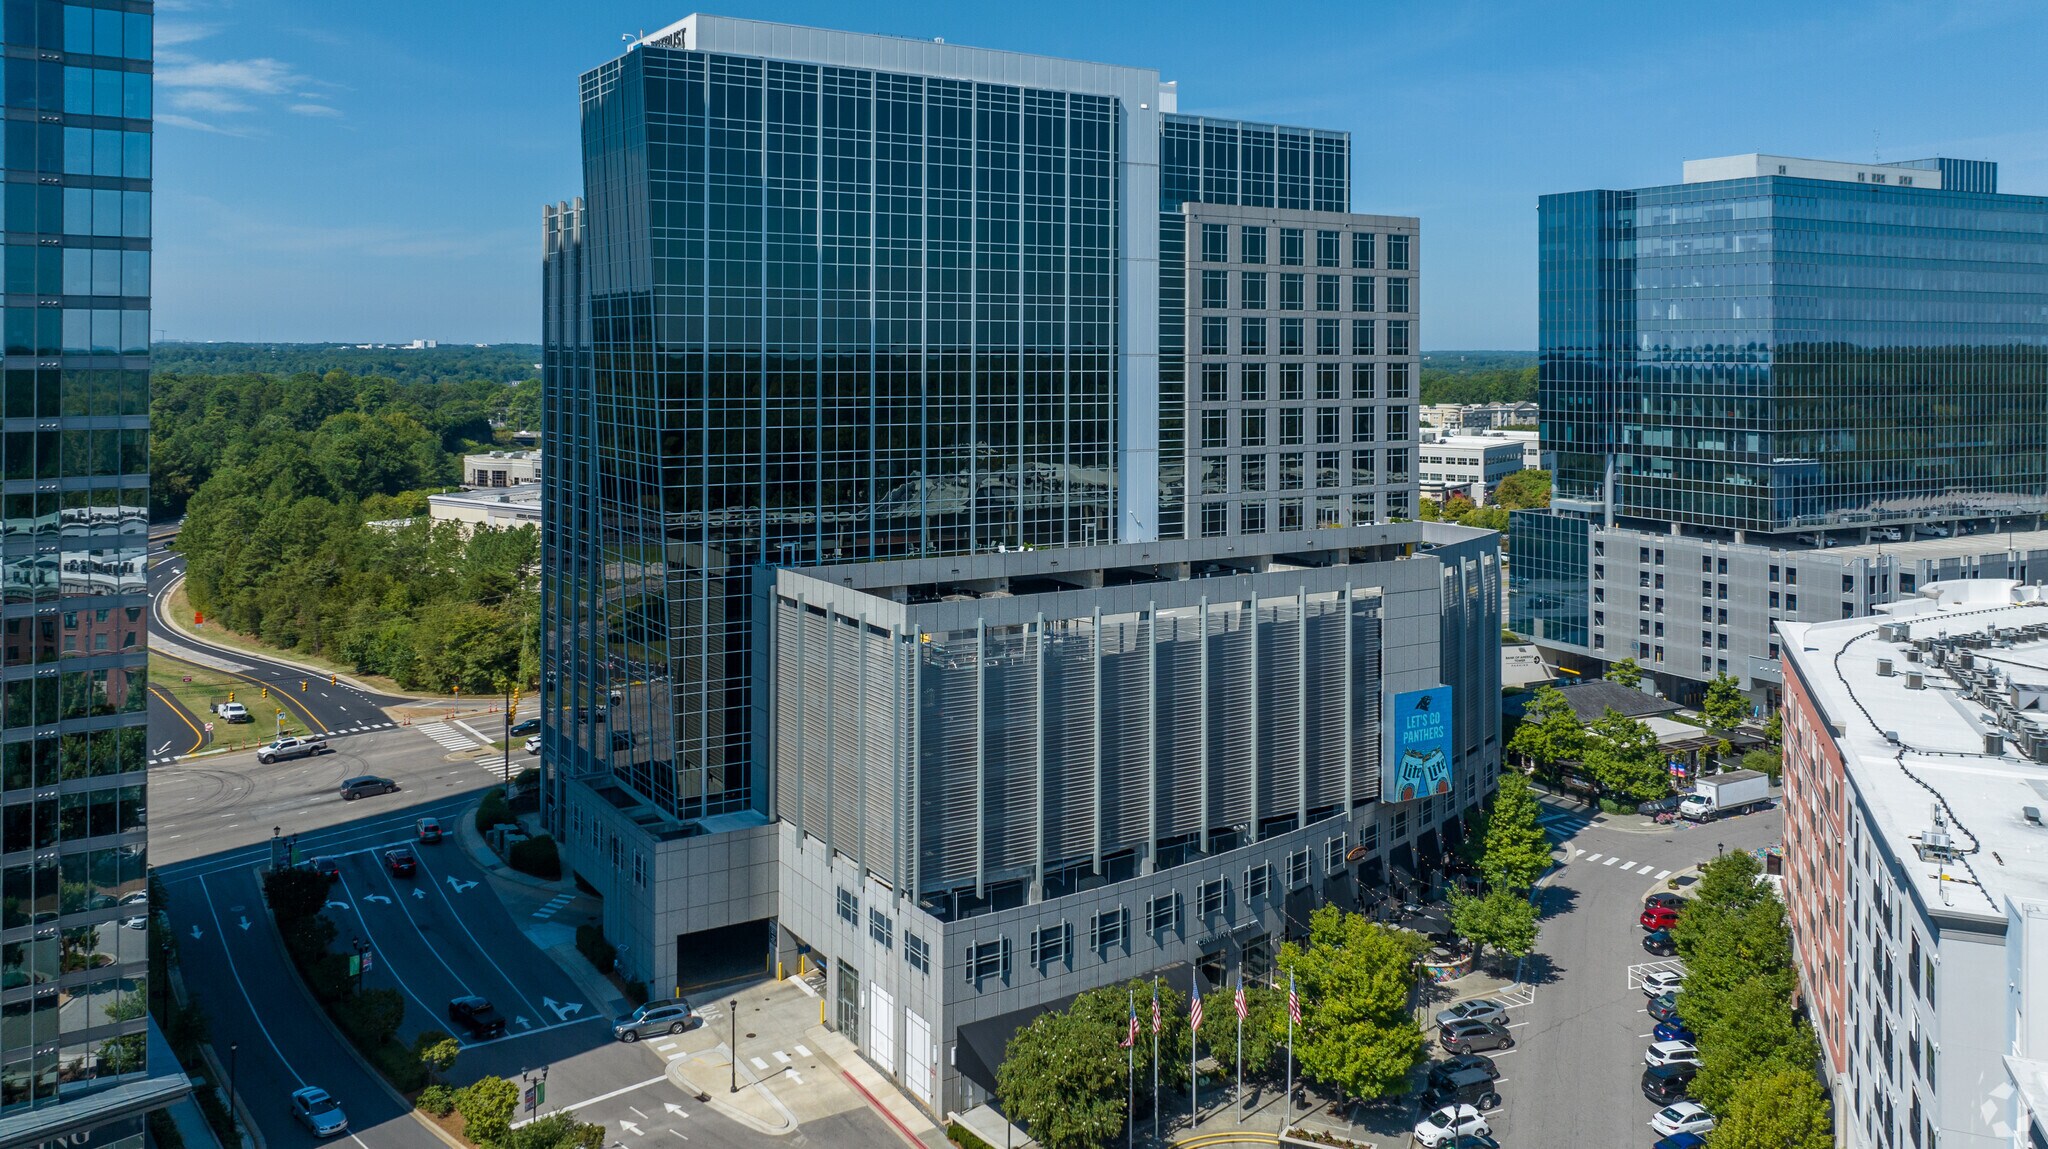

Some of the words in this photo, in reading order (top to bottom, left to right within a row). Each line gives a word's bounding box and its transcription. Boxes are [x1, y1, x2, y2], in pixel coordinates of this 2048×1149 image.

[1406, 713, 1428, 729] LET'S
[1429, 711, 1440, 725] GO
[1403, 725, 1444, 744] PANTHERS
[1402, 761, 1421, 781] Lite
[1427, 759, 1446, 781] Lite
